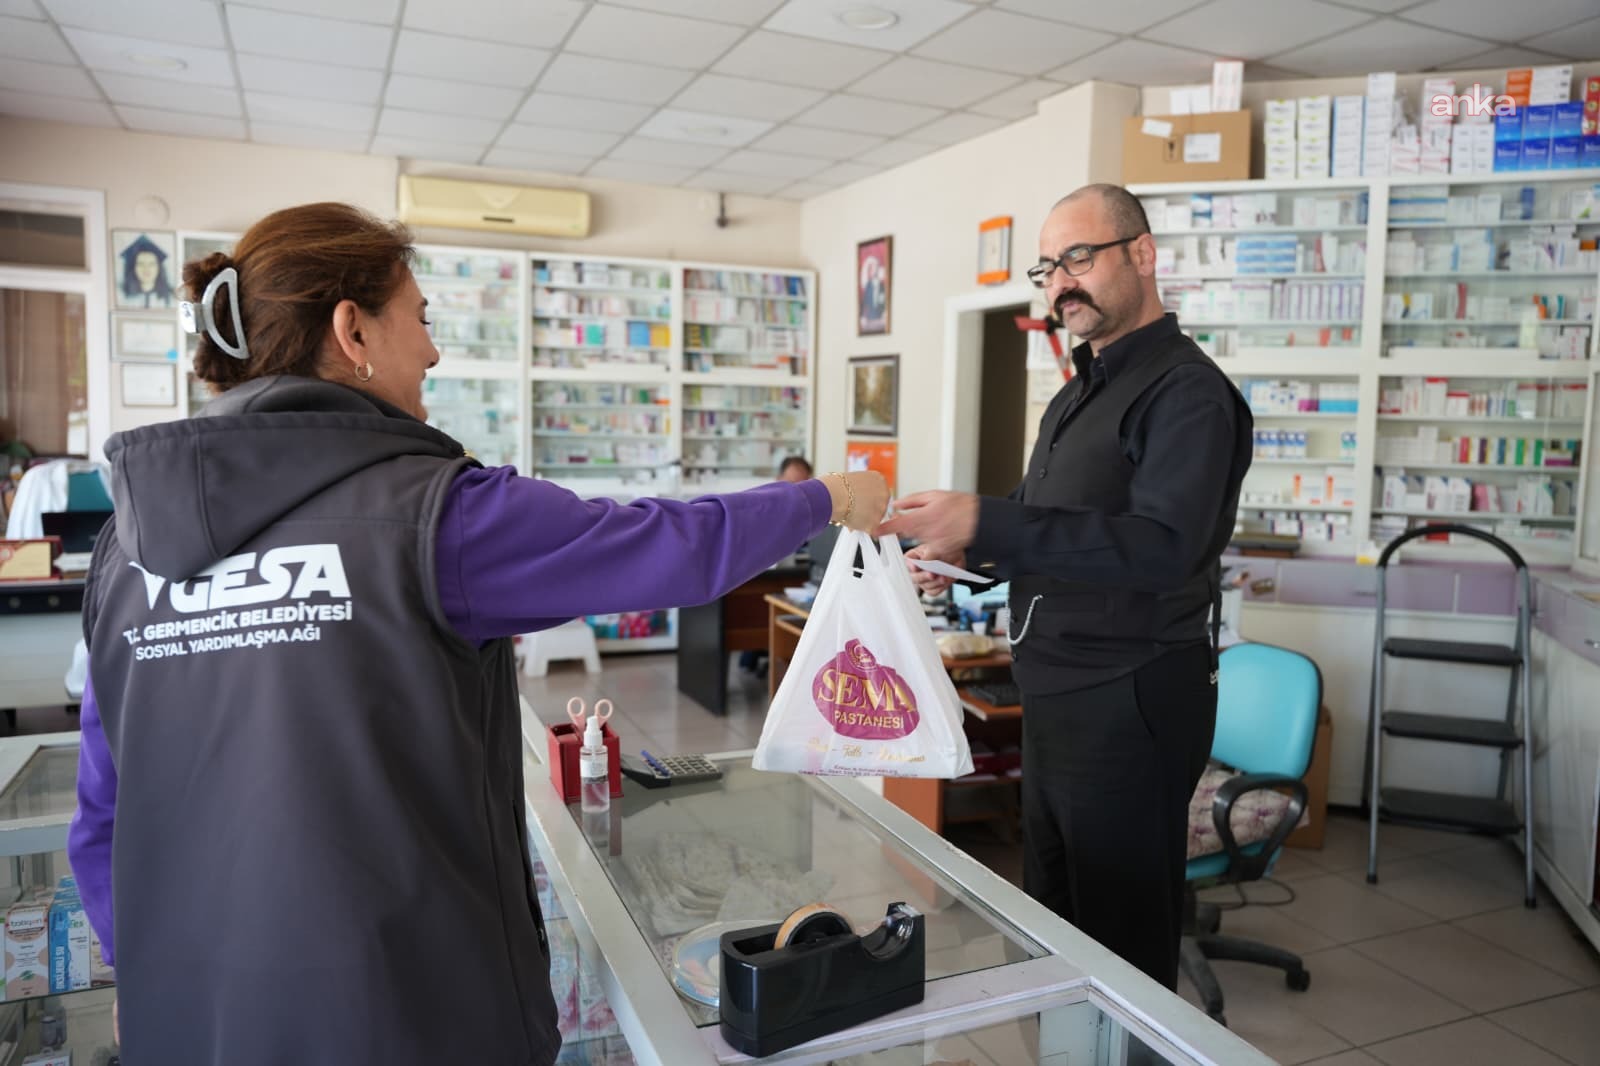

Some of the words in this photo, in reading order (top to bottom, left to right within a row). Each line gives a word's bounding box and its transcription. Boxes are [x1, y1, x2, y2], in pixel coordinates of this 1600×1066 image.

[143, 610, 238, 641] GERMENCİK
[240, 600, 352, 628] BELEDİYESİ
[135, 641, 188, 661] SOSYAL
[188, 628, 290, 654] YARDIMLAŞMA
[290, 623, 321, 642] AĞI
